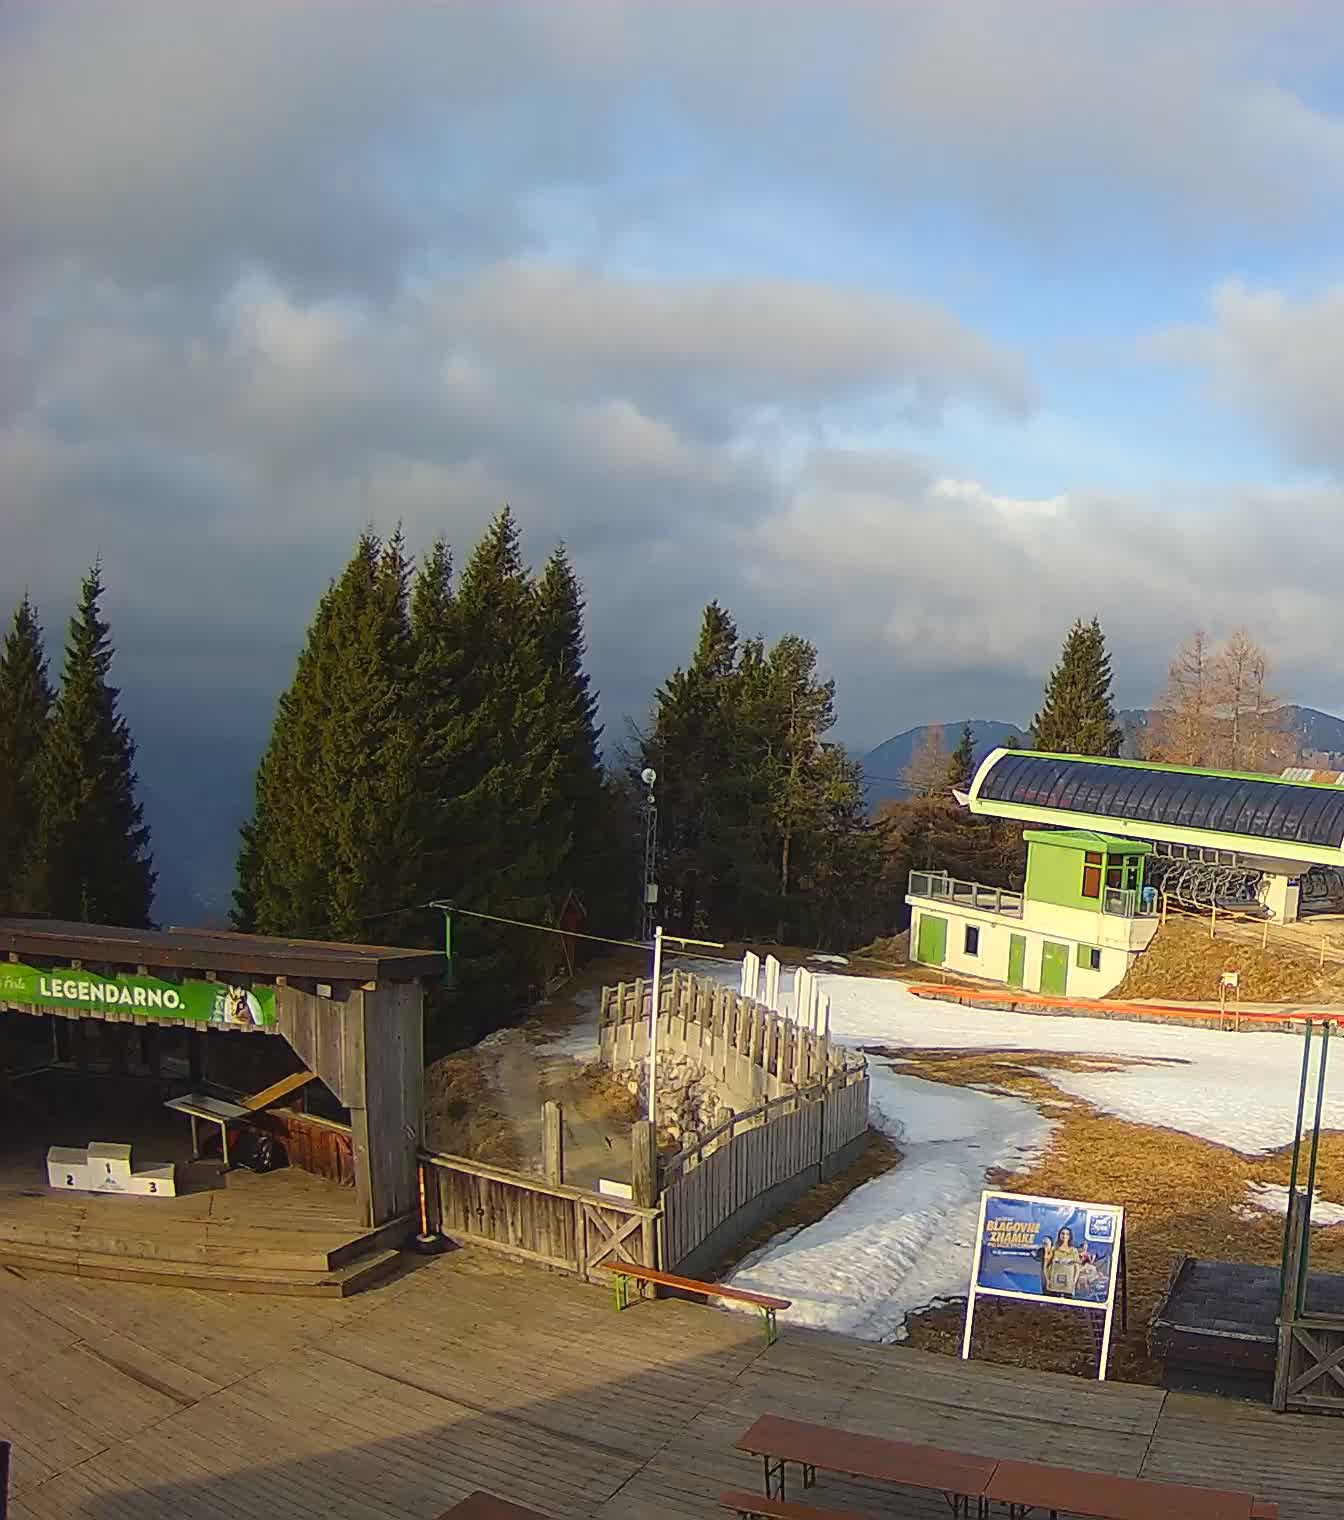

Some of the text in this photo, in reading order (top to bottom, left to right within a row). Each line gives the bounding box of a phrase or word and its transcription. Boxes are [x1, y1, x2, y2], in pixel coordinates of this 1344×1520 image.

[40, 977, 185, 1009] LEGENDARNO.
[105, 1162, 111, 1174] 1
[66, 1175, 74, 1185] 2
[148, 1182, 157, 1193] 3
